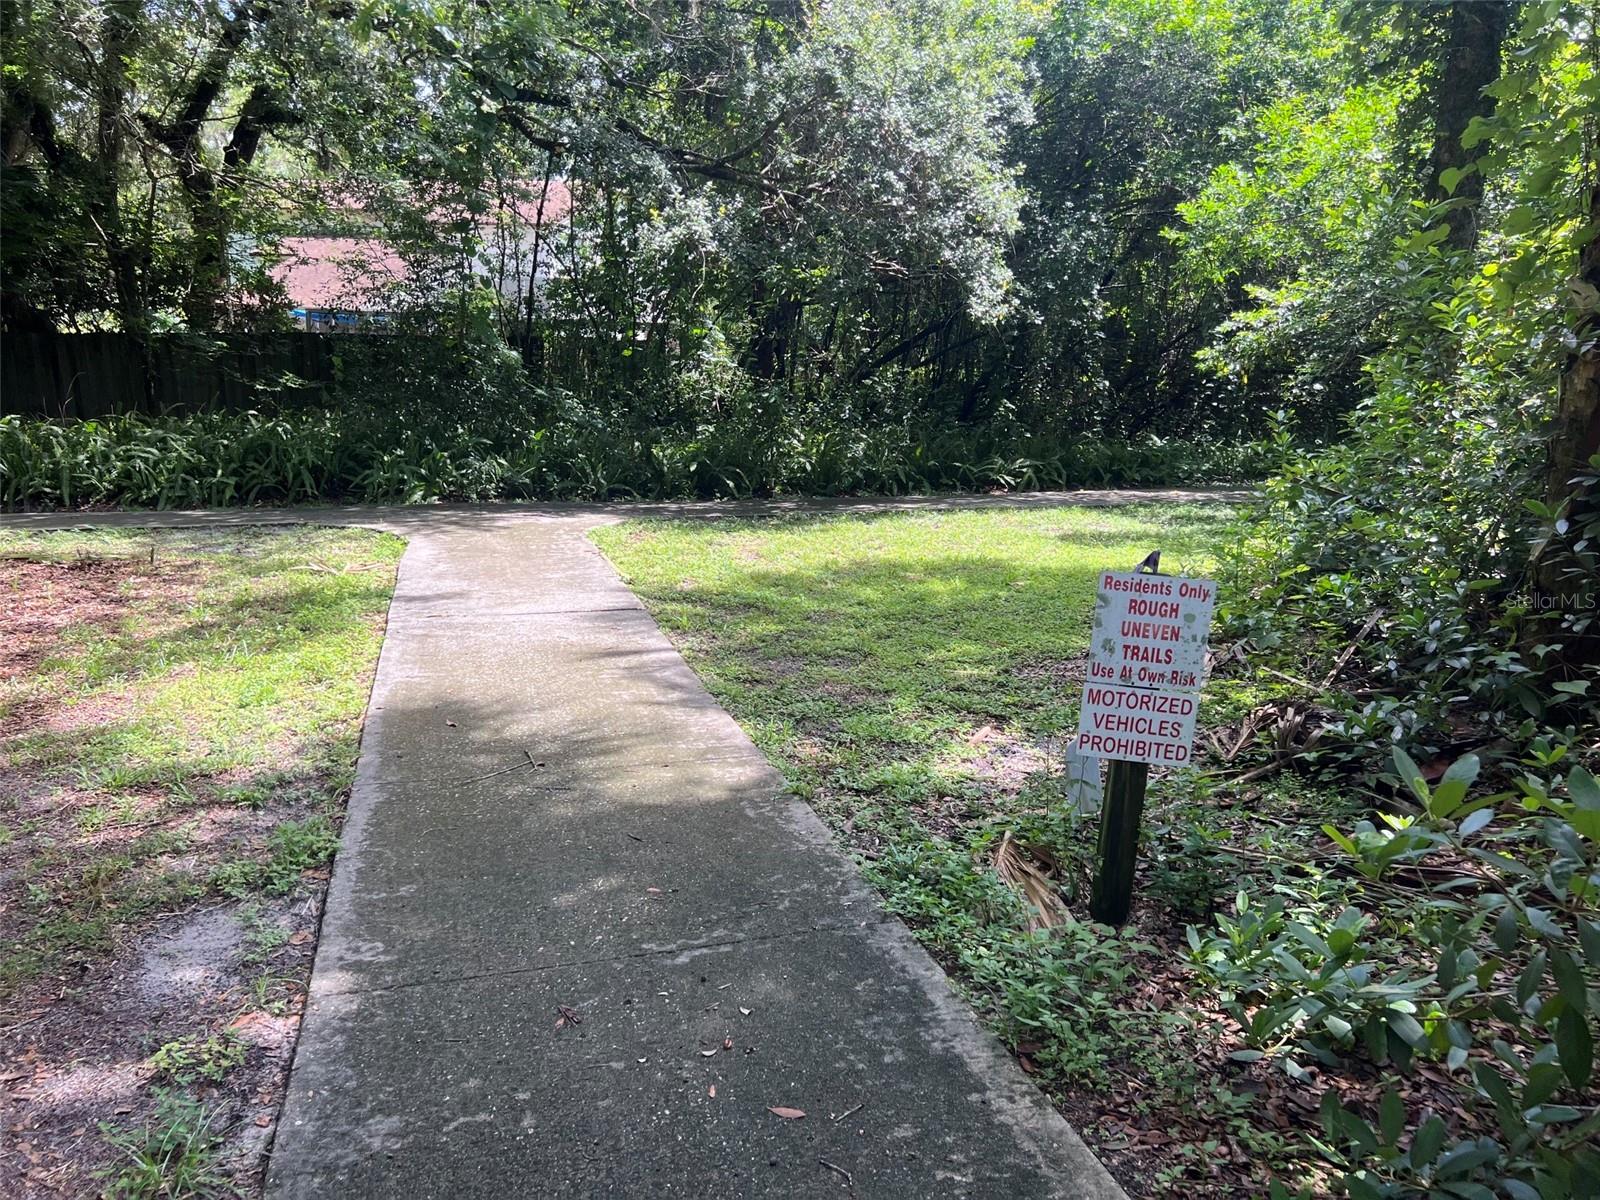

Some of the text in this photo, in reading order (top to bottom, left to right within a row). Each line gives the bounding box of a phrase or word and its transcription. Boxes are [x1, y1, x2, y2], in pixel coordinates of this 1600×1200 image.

[1103, 575, 1210, 602] Residents Only
[1128, 598, 1180, 619] ROUGH
[1121, 620, 1181, 642] UNEVEN
[1122, 644, 1173, 665] TRAILS
[1091, 662, 1197, 687] Use At Own Risk
[1087, 688, 1193, 715] MOTORIZED
[1093, 712, 1182, 738] VEHICLES
[1079, 734, 1188, 761] PROHIBITED
